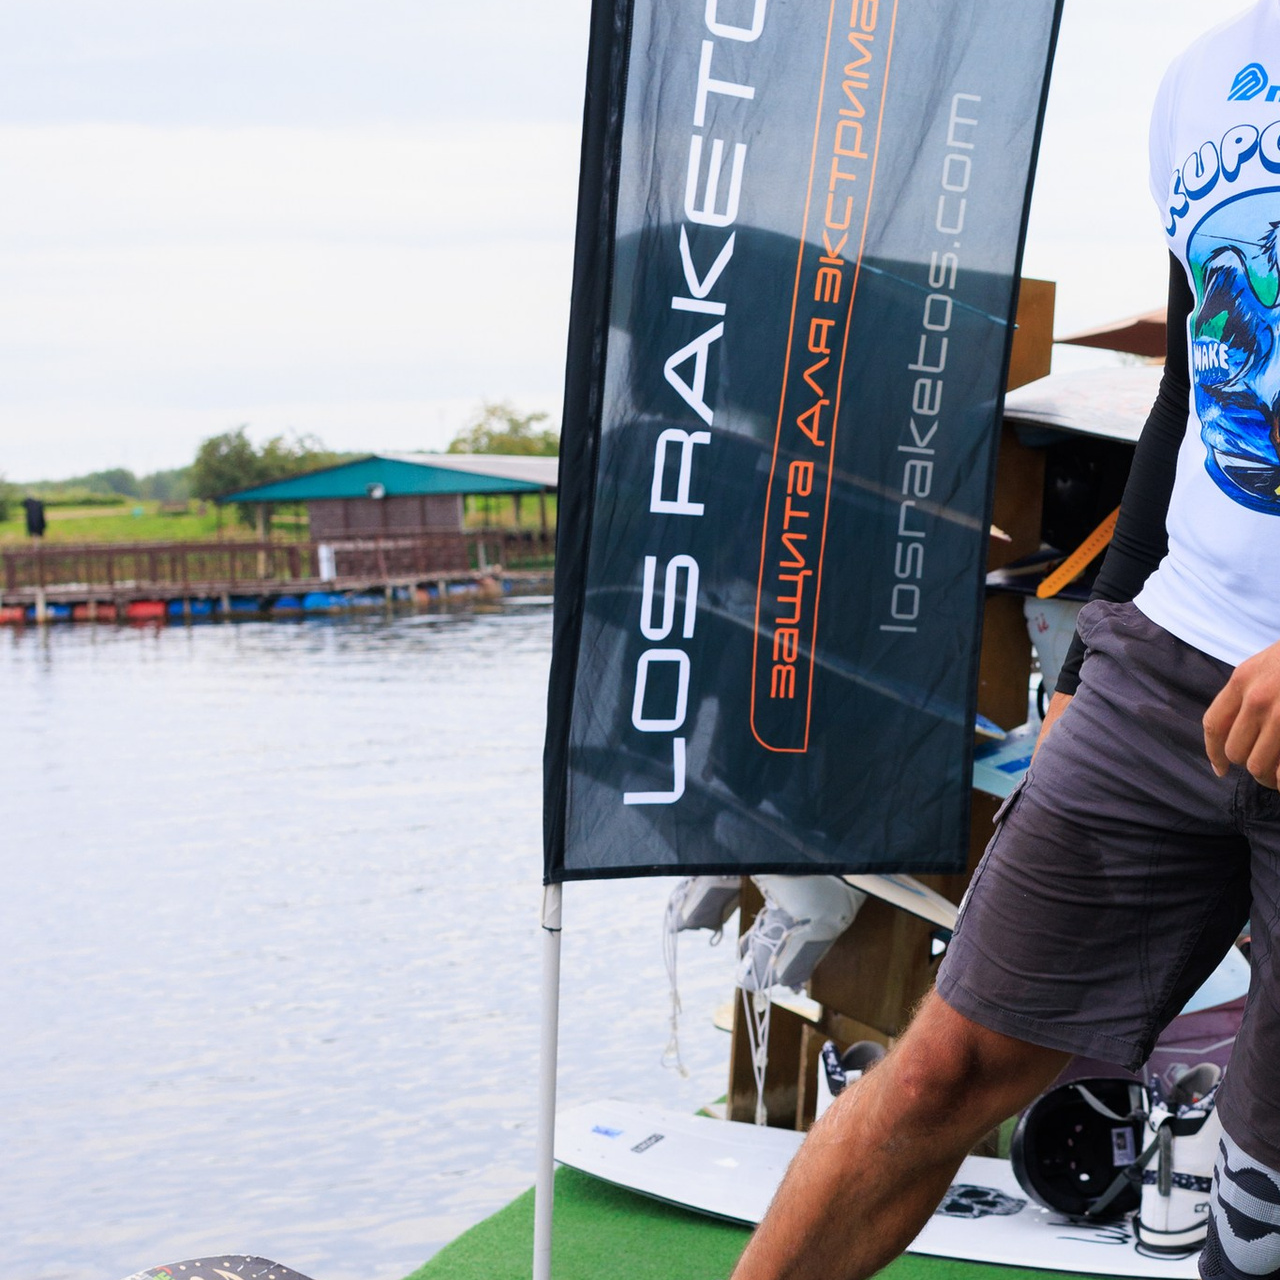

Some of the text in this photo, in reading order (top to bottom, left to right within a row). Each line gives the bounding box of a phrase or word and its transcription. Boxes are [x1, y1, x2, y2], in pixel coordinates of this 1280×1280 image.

[878, 91, 983, 634] losraketos.com
[623, 555, 698, 806] LOS
[768, 460, 814, 700] защита
